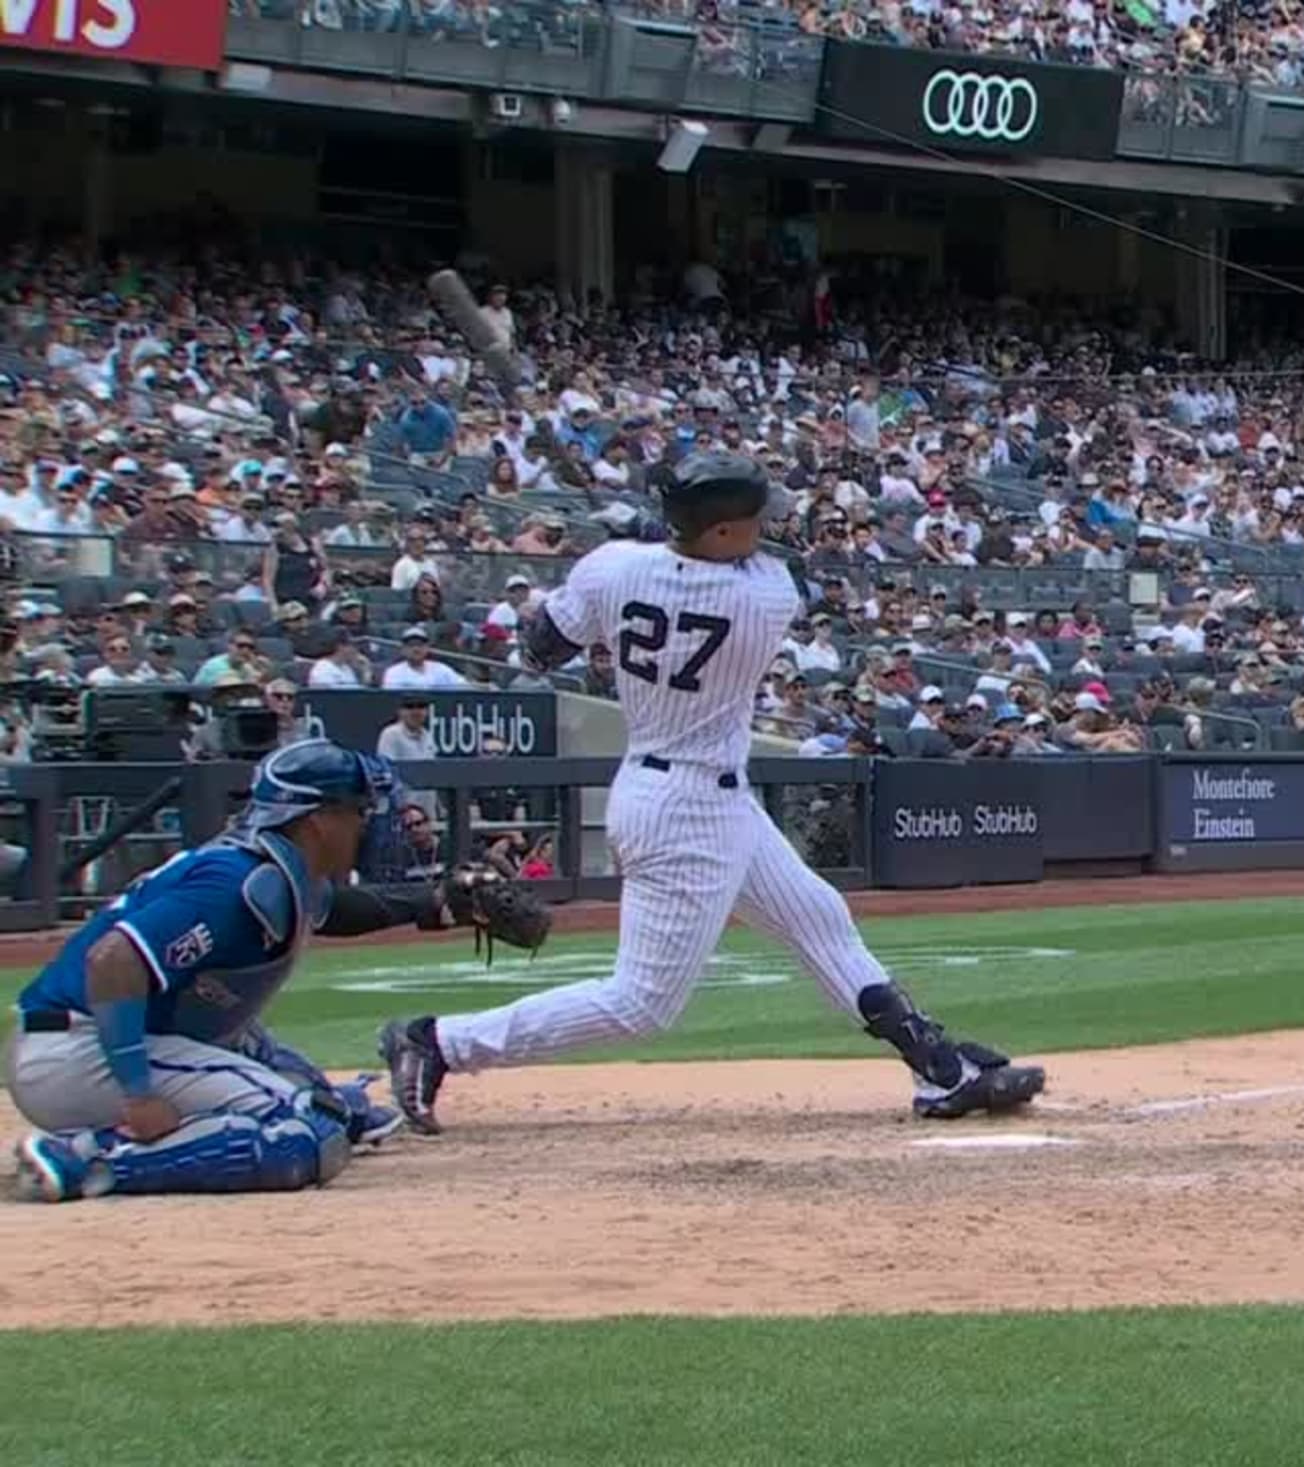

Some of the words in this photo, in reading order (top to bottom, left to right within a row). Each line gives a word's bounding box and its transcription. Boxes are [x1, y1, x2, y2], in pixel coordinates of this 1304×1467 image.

[619, 600, 731, 692] 27
[428, 702, 536, 754] tubHub
[1191, 767, 1277, 801] Montefiore
[895, 807, 963, 839] StubHub
[974, 804, 1038, 836] StubHub
[1192, 807, 1256, 840] Einstein
